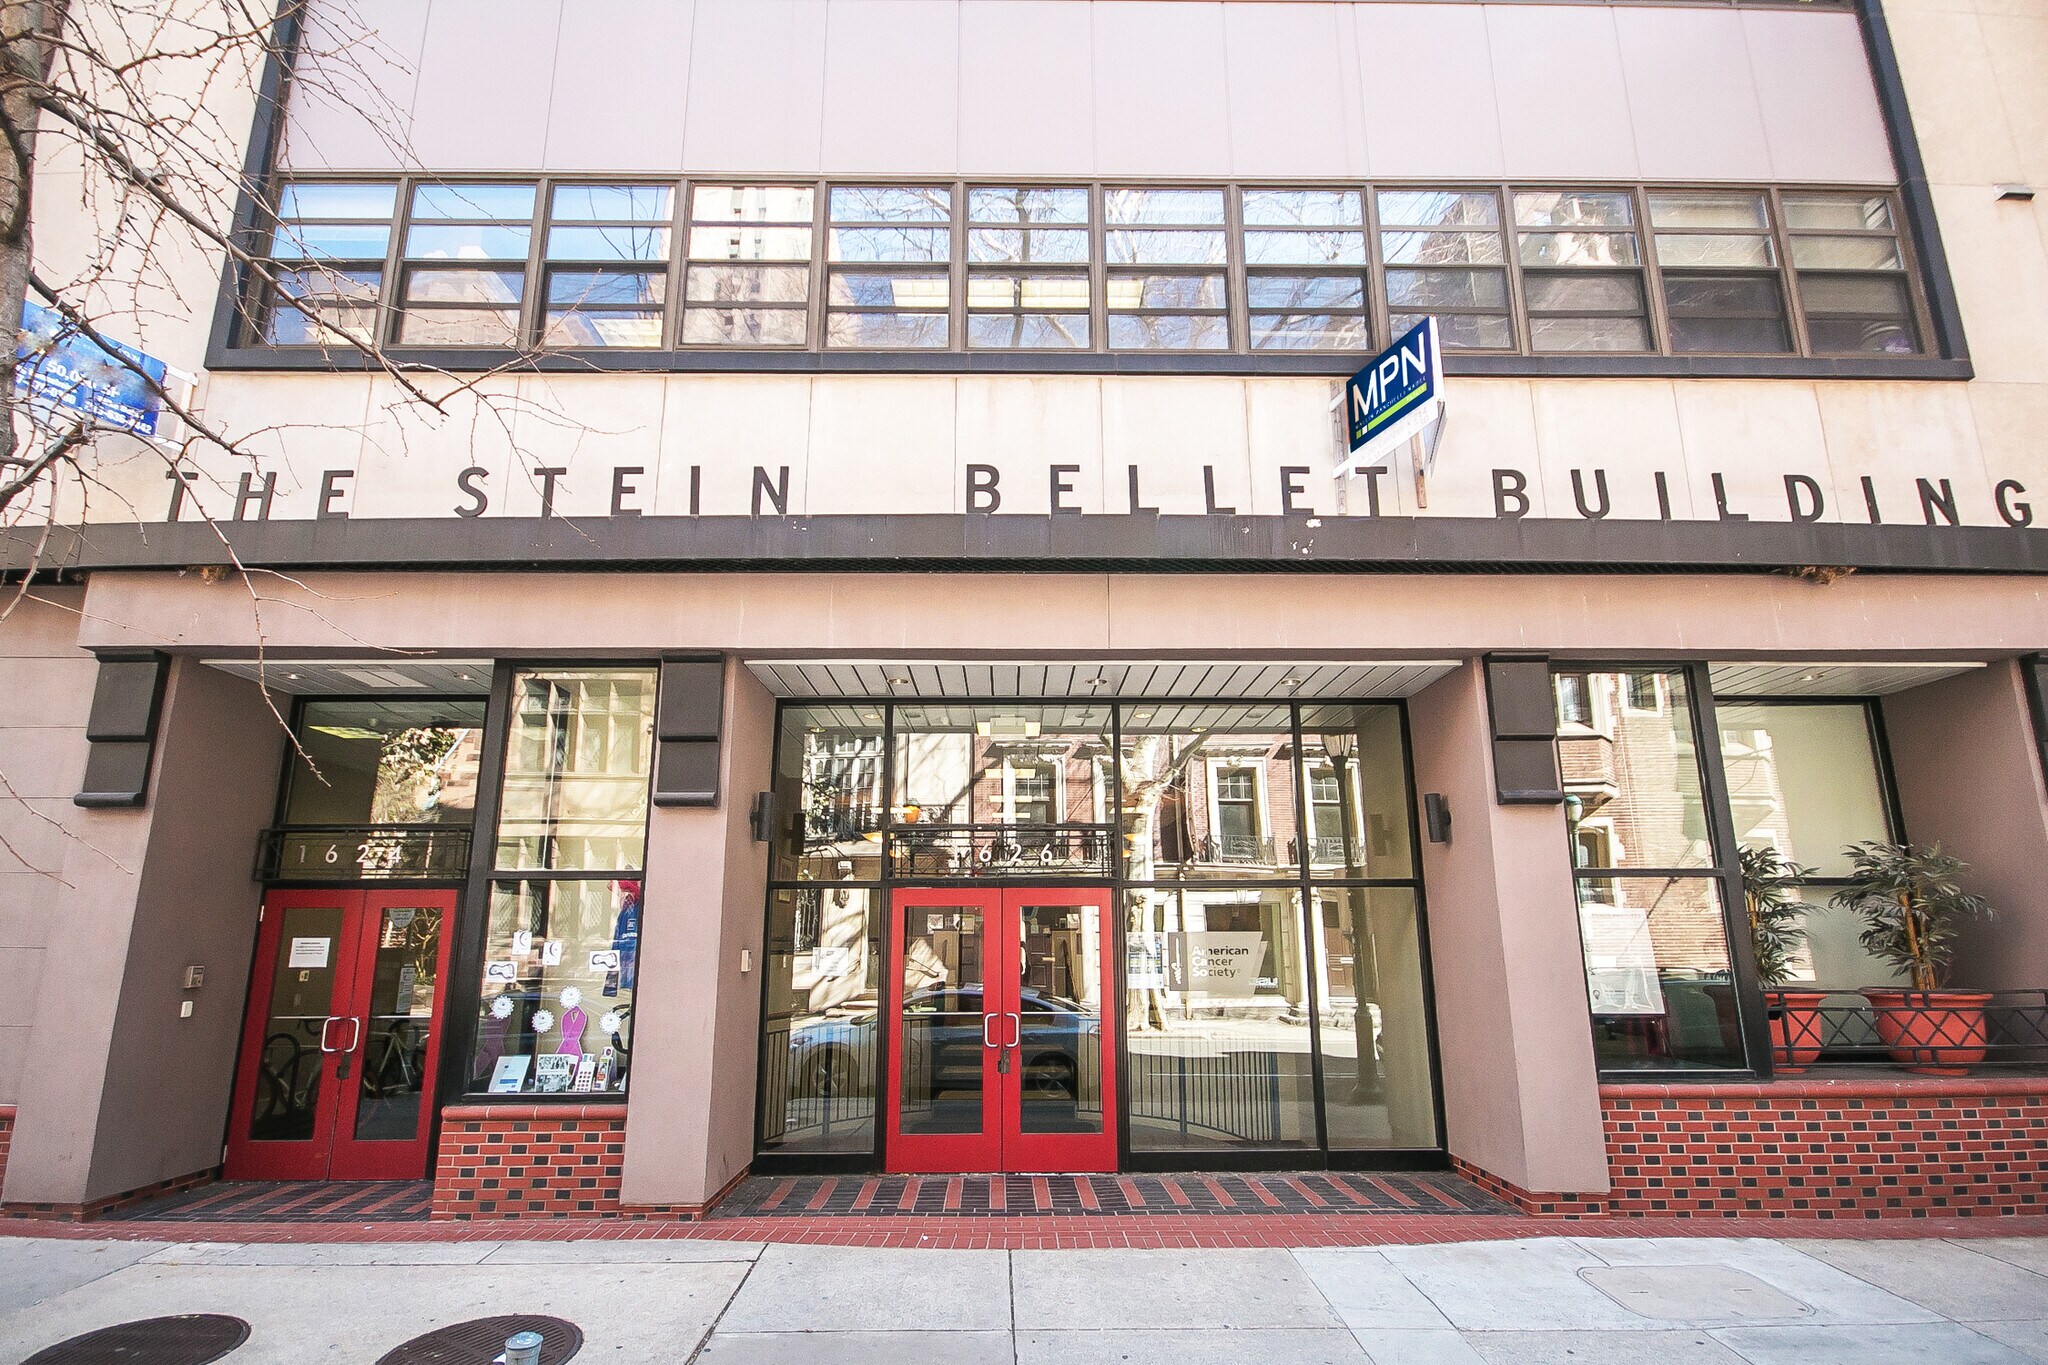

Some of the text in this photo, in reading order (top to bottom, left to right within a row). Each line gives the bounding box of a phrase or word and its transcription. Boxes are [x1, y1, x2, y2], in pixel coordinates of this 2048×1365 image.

[1352, 332, 1426, 423] MPN
[166, 464, 2033, 528] THE STEIN BELLET BUILDING
[300, 844, 402, 864] 1624
[952, 842, 1053, 865] 1626
[1192, 945, 1249, 956] American
[1192, 957, 1233, 967] Cancer
